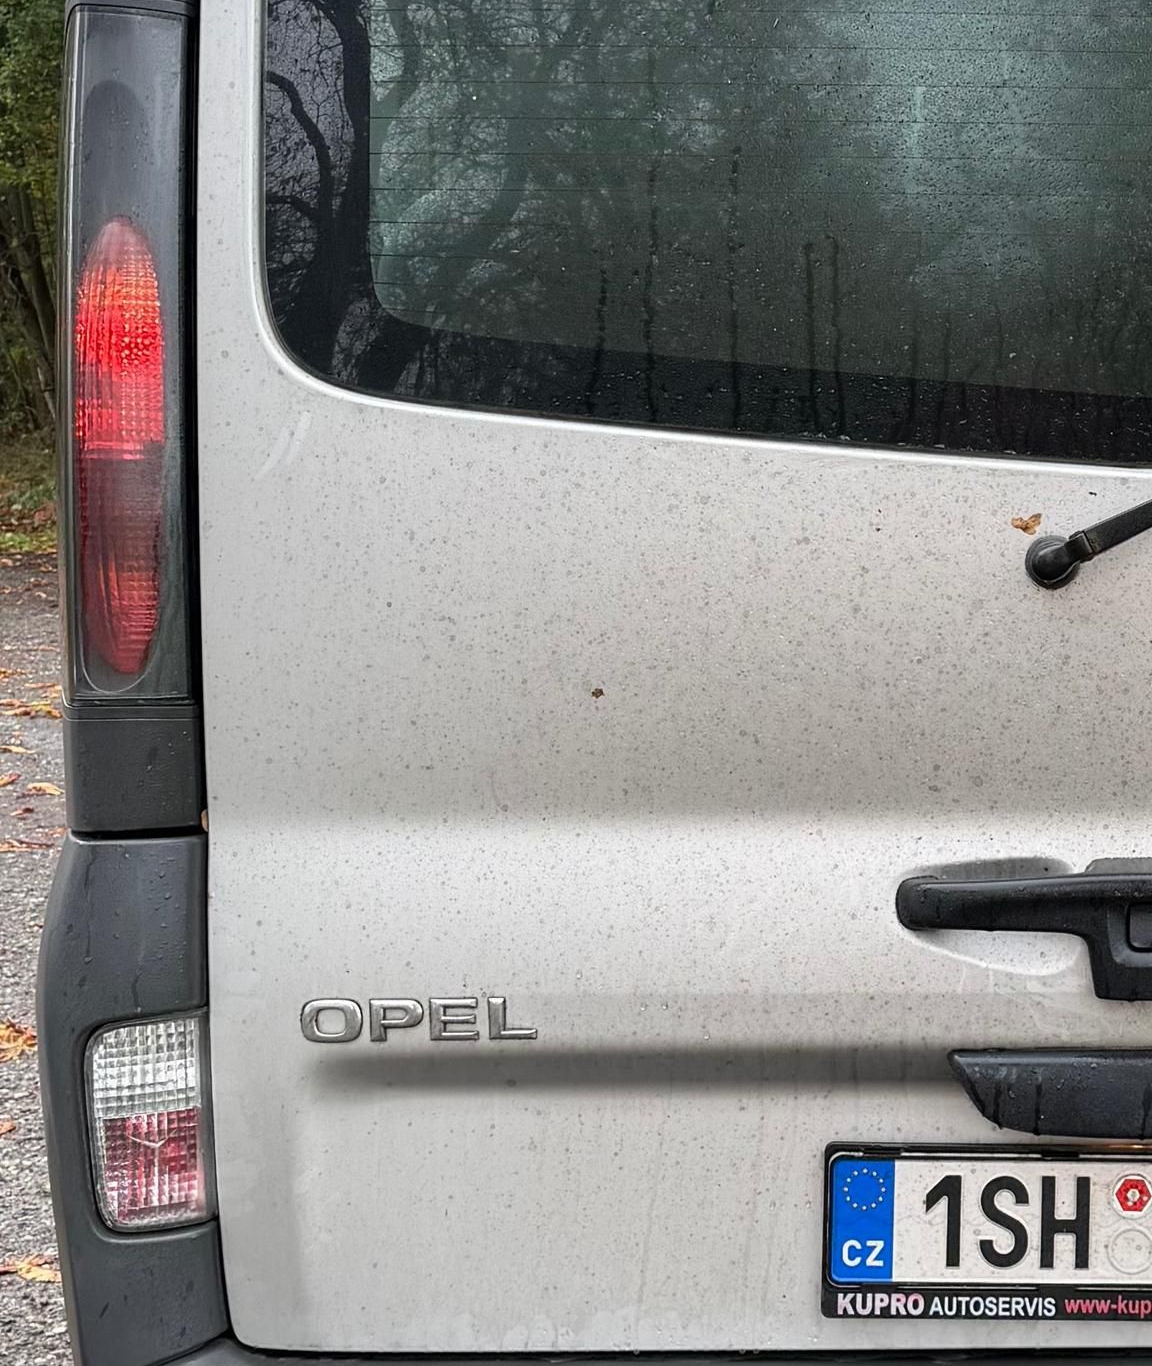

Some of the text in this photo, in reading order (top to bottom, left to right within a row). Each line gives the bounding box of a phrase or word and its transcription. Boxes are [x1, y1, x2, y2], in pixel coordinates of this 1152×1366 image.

[301, 997, 538, 1043] OPEL
[924, 1175, 1091, 1268] 1SH
[842, 1238, 885, 1268] CZ
[837, 1293, 925, 1316] KUPRO
[929, 1296, 1056, 1317] AUTOSERVIS
